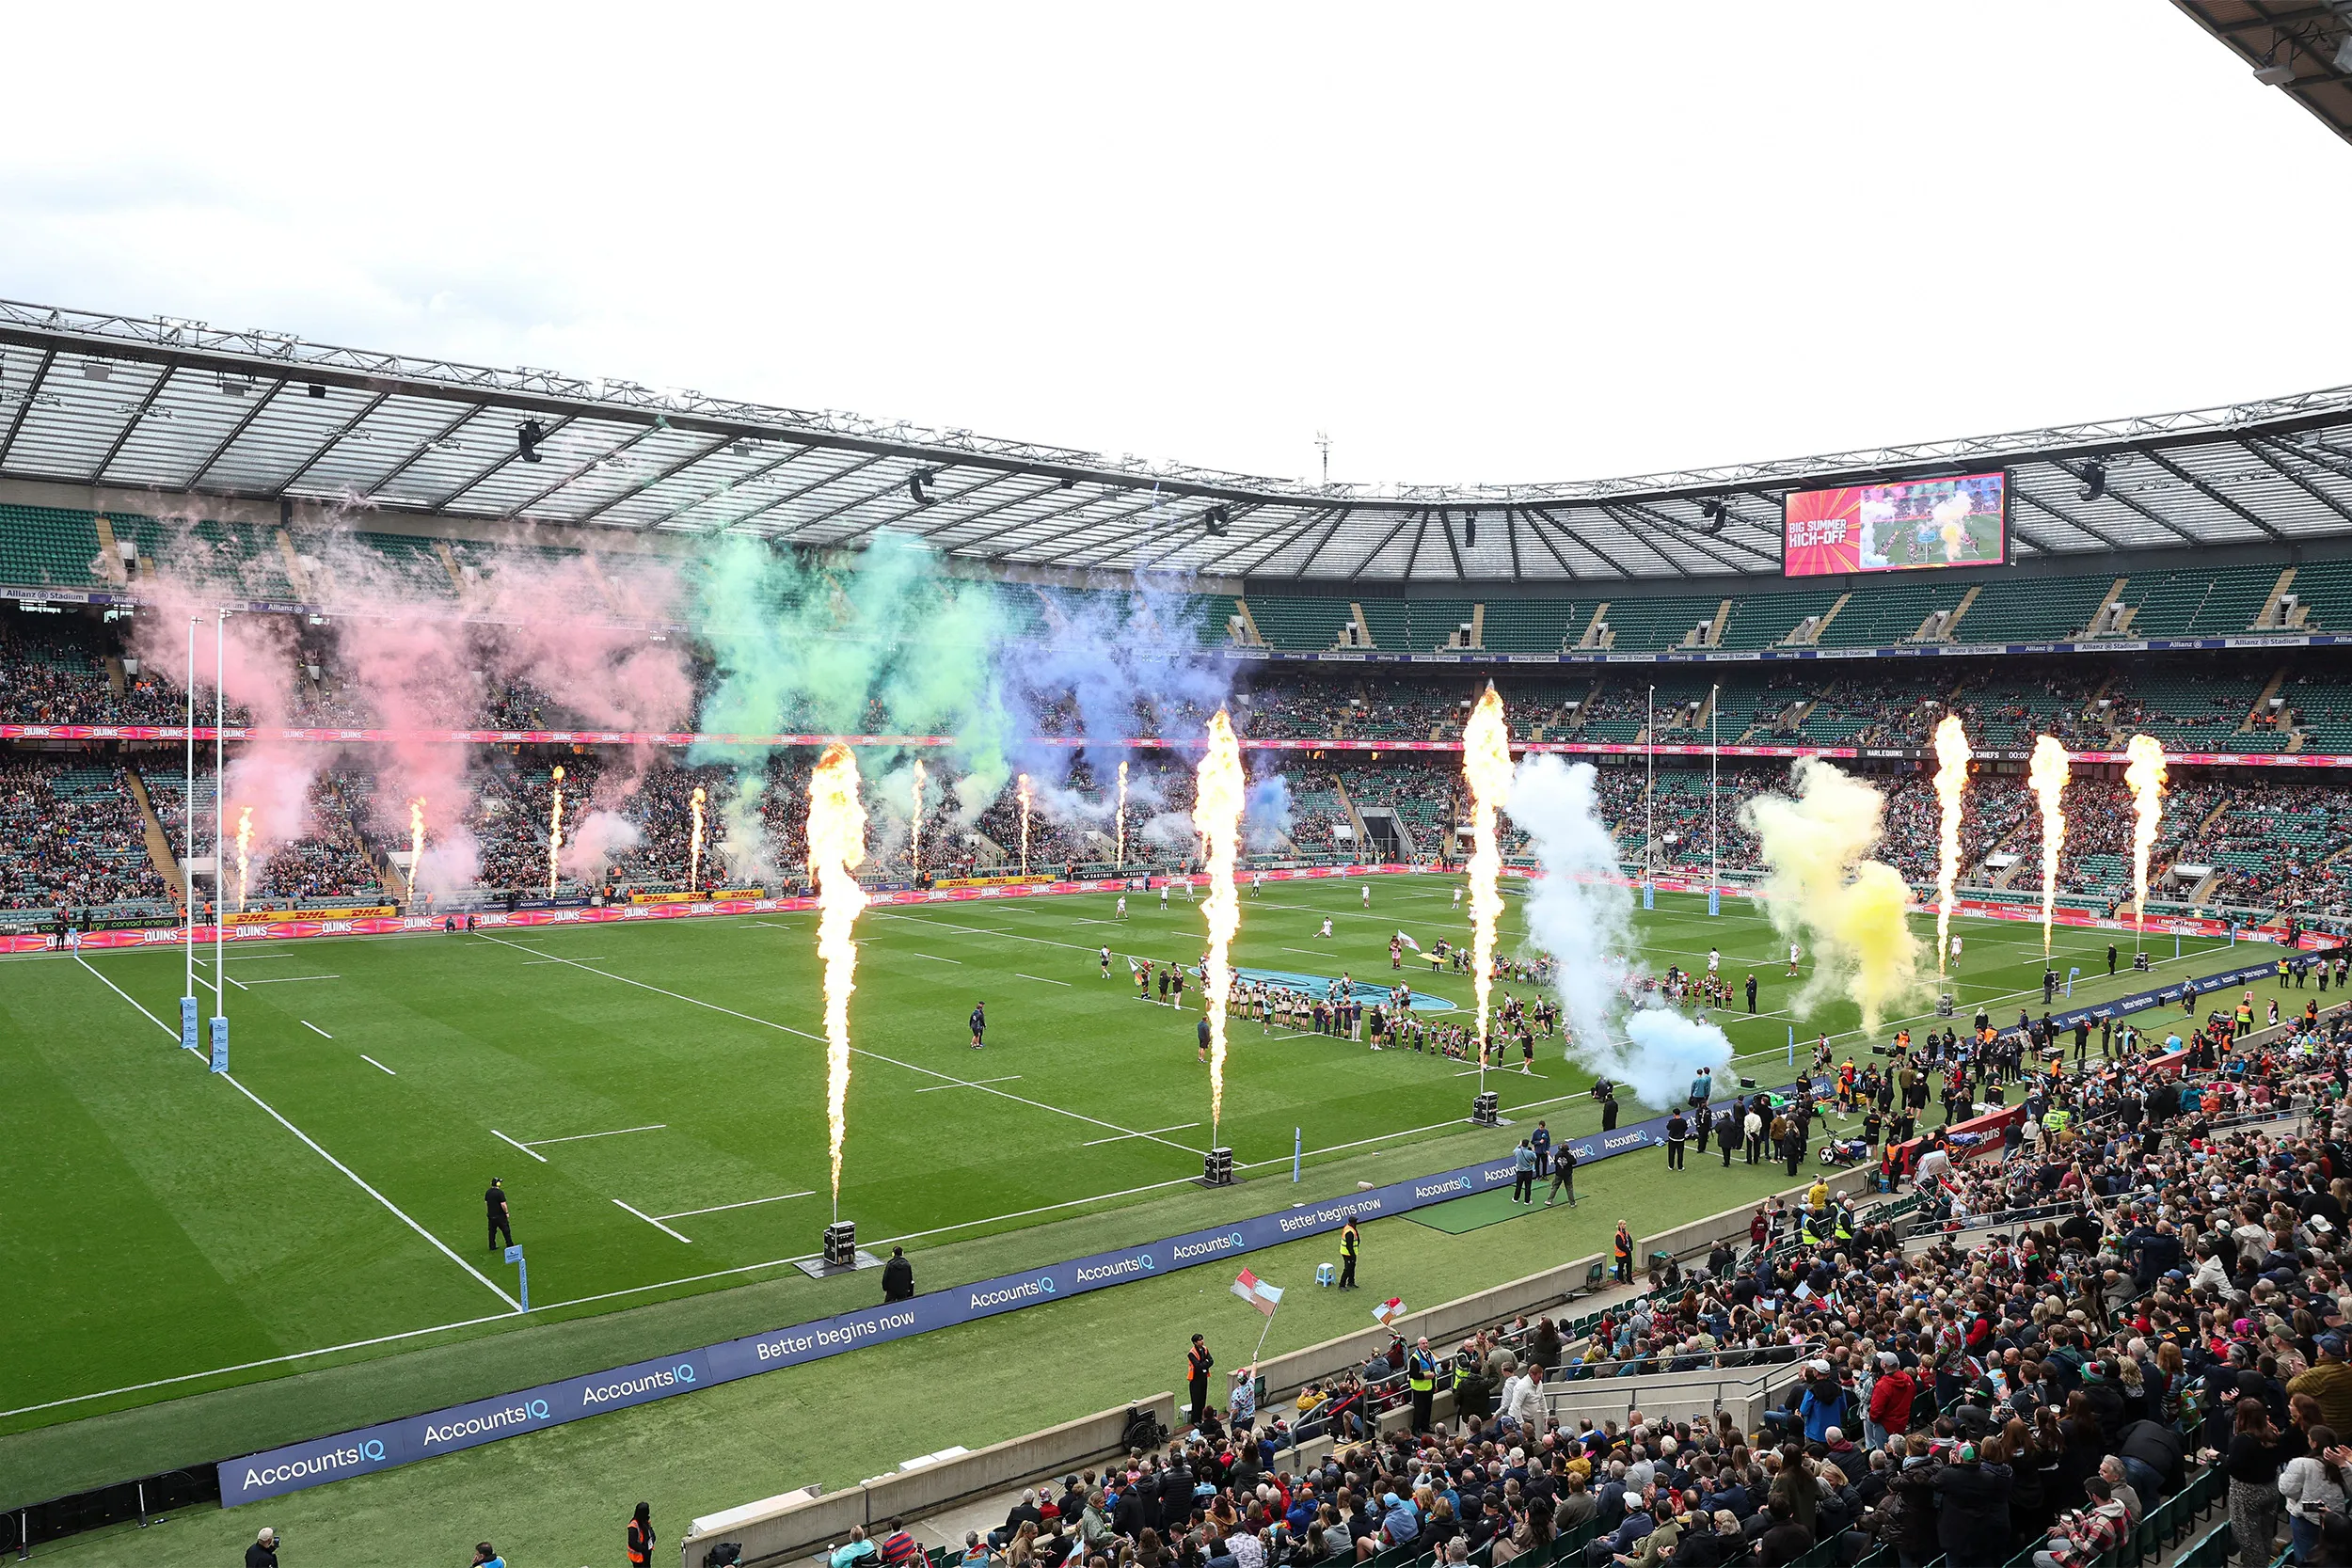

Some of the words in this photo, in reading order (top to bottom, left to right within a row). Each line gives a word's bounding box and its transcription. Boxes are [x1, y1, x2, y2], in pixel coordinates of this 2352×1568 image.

[1789, 522, 1805, 534] BIG
[1807, 519, 1847, 532] SUMMER
[1788, 531, 1847, 548] KICK-OFF
[7, 590, 36, 598] Allianz
[50, 592, 84, 602] Stadium
[110, 594, 138, 604] Allianz
[268, 604, 294, 612] Allianz
[2334, 635, 2352, 643] Allia
[24, 728, 50, 737] QUINS
[93, 728, 119, 737] QUINS
[160, 728, 183, 737] QUINS
[222, 730, 246, 739] QUINS
[283, 731, 305, 739] QUINS
[341, 731, 362, 739] QUINS
[452, 732, 470, 741] QUINS
[502, 733, 522, 741] QUINS
[553, 733, 572, 741] QUINS
[1867, 750, 1903, 758] HARLEQUINS
[2009, 752, 2029, 760] 00:00
[2218, 754, 2240, 764] QUINS
[2276, 756, 2298, 765] QUINS
[1293, 869, 1308, 878] QUINS
[1409, 865, 1428, 874] QUINS
[1507, 869, 1523, 878] QUINS
[1170, 877, 1187, 885] QUINS
[1032, 885, 1050, 894] QUINS
[1080, 882, 1097, 891] QUINS
[1686, 885, 1705, 894] QUINS
[928, 892, 948, 900] QUINS
[981, 888, 1001, 897] QUINS
[873, 894, 894, 903] QUINS
[691, 904, 715, 914] QUINS
[755, 901, 776, 911] QUINS
[237, 913, 271, 922] DHL
[294, 911, 327, 920] DHL
[350, 909, 383, 917] DHL
[554, 911, 580, 922] QUINS
[625, 908, 649, 918] QUINS
[1963, 908, 1987, 918] QUINS
[111, 920, 141, 928] conrad
[145, 918, 173, 927] energy
[405, 918, 433, 929] QUINS
[480, 914, 508, 926] QUINS
[2096, 920, 2122, 929] QUINS
[236, 926, 267, 938] QUINS
[322, 922, 352, 933] QUINS
[2169, 926, 2198, 937] QUINS
[144, 930, 178, 943] QUINS
[1604, 1129, 1648, 1150] AccountsIQ
[1485, 1163, 1518, 1182] Accoun
[1415, 1176, 1472, 1199] AccountsIQ
[1279, 1213, 1315, 1232] Better
[1317, 1204, 1356, 1226] begins
[1357, 1196, 1381, 1213] now
[1173, 1232, 1246, 1260] AccountsIQ
[1076, 1253, 1155, 1283] AccountsIQ
[970, 1275, 1056, 1309] AccountsIQ
[756, 1334, 814, 1361] Better
[818, 1319, 877, 1347] begins
[880, 1311, 916, 1332] now
[582, 1364, 696, 1405] AccountsIQ
[423, 1398, 550, 1447] AccountsIQ
[243, 1439, 386, 1490] AccountsIQ
